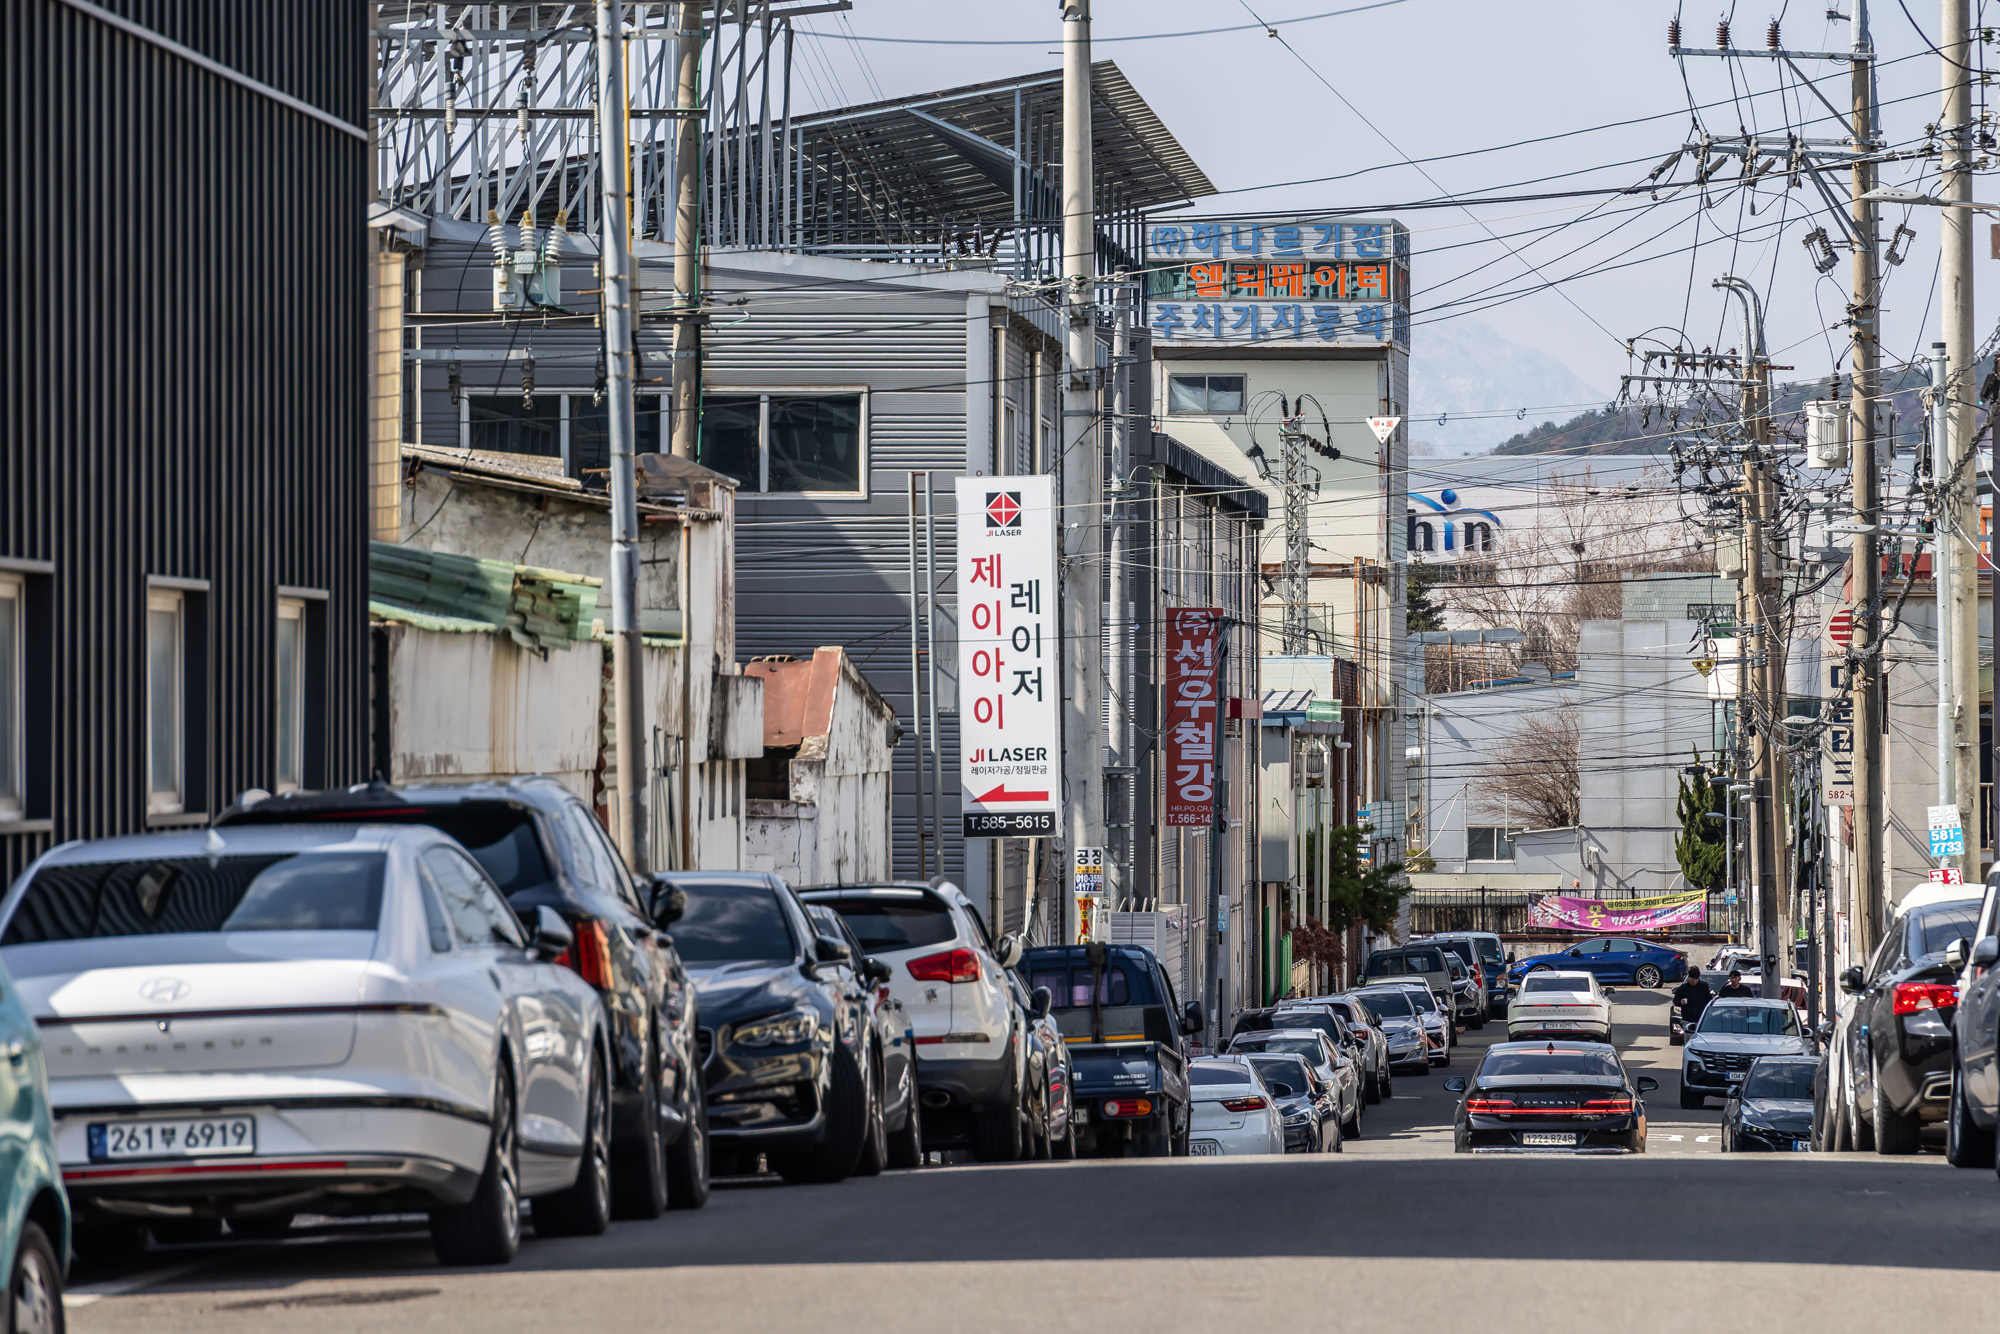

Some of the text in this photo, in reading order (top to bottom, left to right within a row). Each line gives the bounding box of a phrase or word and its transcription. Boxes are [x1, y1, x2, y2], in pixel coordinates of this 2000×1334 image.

[1151, 223, 1383, 258] (주)하나로기전
[1190, 264, 1389, 297] 엘리베이터
[995, 529, 1022, 537] LASER
[970, 553, 1004, 729] 제이아이
[1011, 579, 1042, 702] 레이저
[969, 747, 1047, 763] JI LASER
[971, 765, 1047, 775] 레이저가공/정밀판금
[968, 815, 1050, 830] T.585-5615
[1931, 830, 1960, 841] 581-
[1932, 841, 1962, 854] 7733
[1077, 849, 1102, 865] 공장
[1611, 914, 1652, 926] 마사지
[1190, 1144, 1212, 1156] 4361
